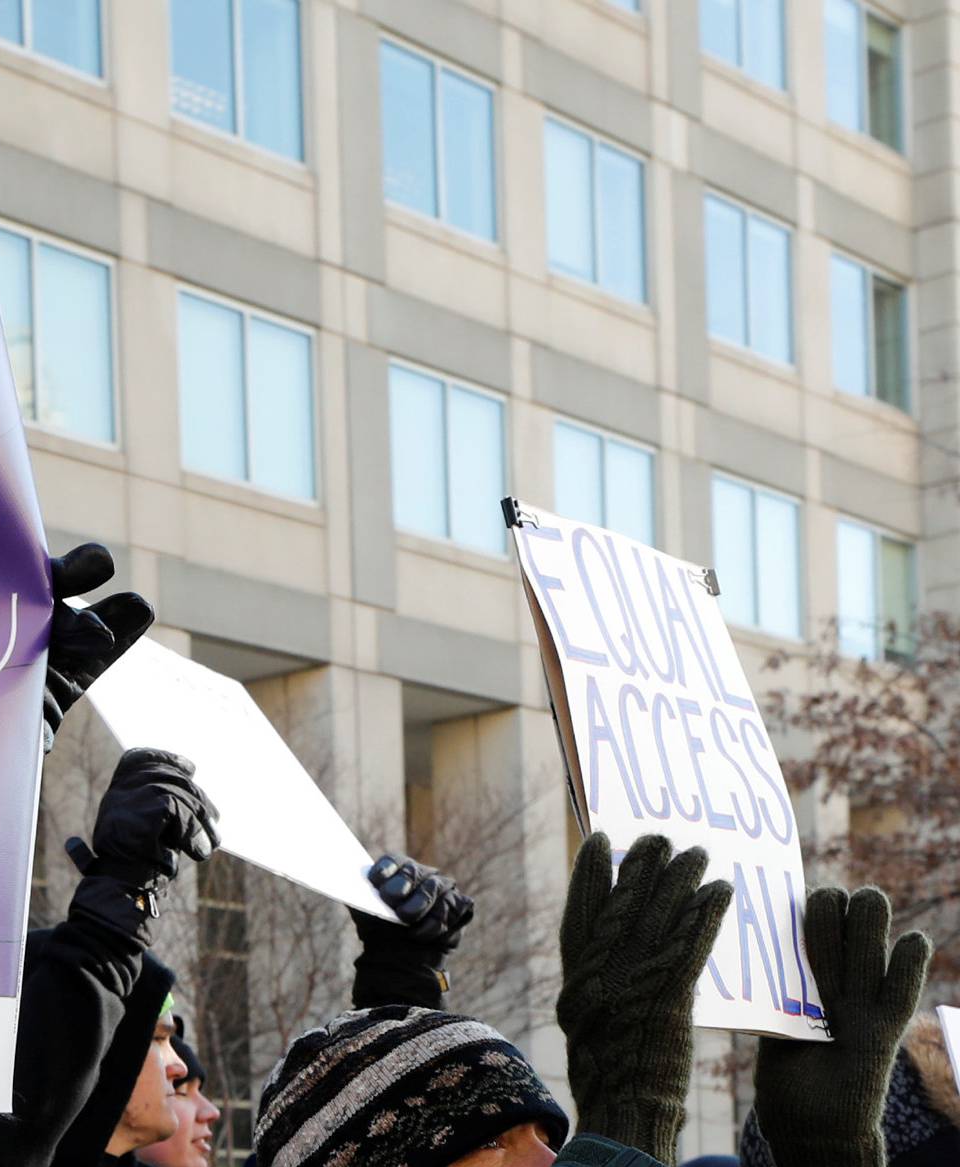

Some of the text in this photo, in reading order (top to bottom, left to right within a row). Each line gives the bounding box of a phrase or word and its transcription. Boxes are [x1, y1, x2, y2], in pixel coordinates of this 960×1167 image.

[520, 526, 755, 712] EQUAL
[585, 674, 795, 845] ACCESS
[732, 861, 824, 1020] ALL
